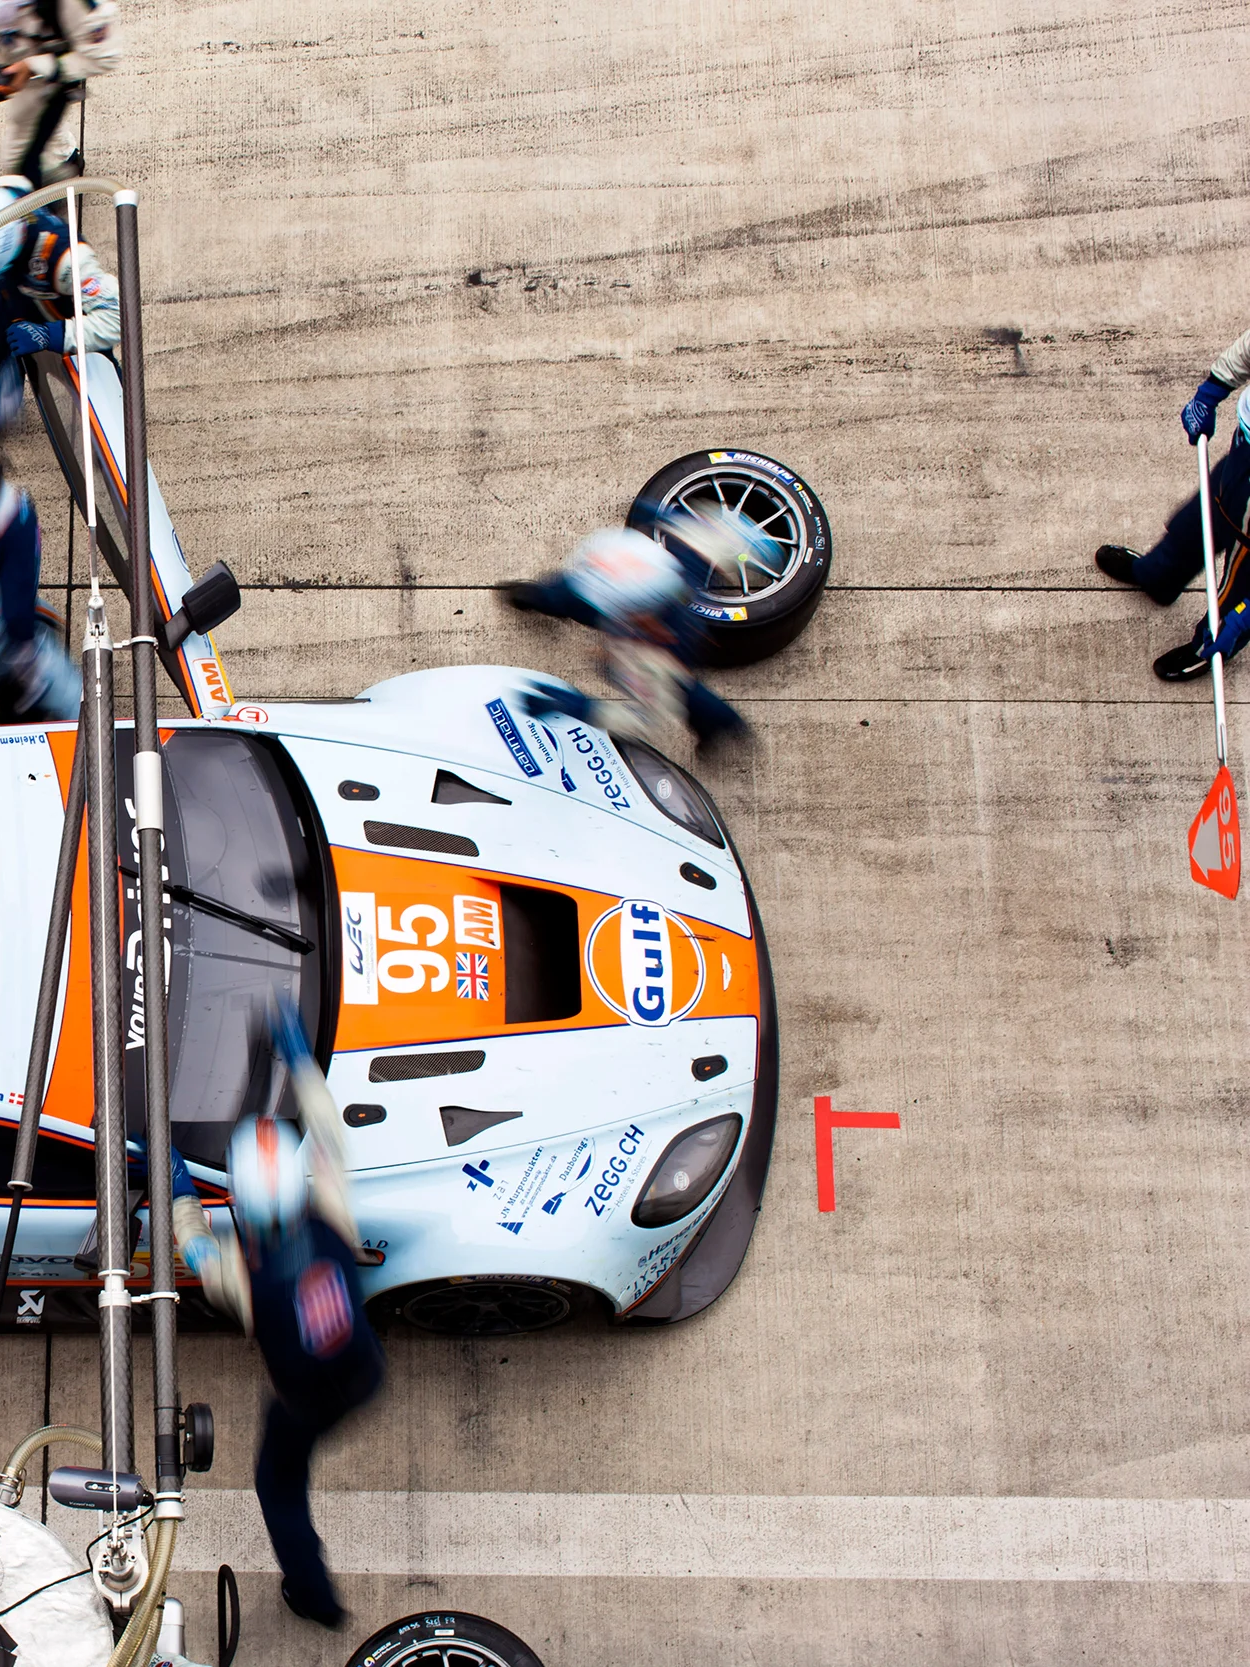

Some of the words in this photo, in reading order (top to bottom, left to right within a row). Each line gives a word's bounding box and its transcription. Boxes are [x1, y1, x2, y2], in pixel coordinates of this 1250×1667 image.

[733, 452, 794, 483] MICHELIN
[201, 663, 228, 704] AM
[348, 906, 364, 976] WEC
[377, 903, 450, 994] 95
[463, 898, 495, 945] AM
[630, 903, 667, 1021] Gulf
